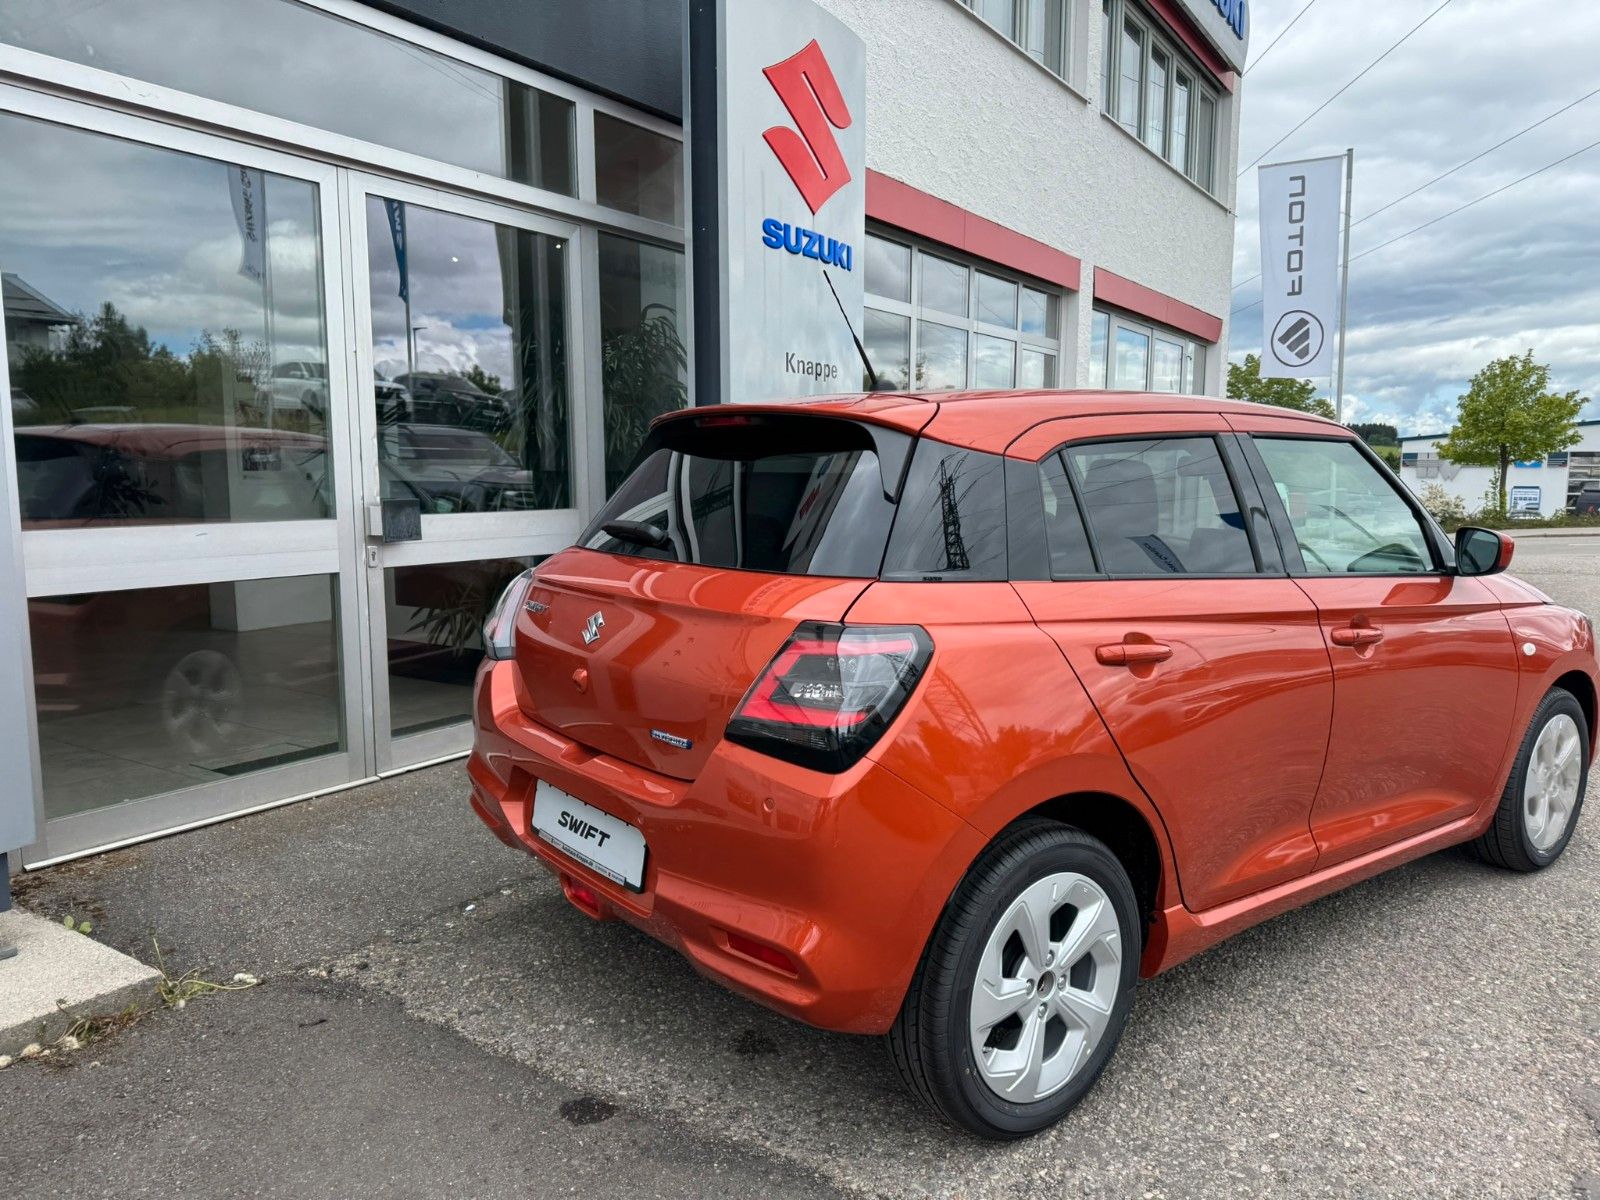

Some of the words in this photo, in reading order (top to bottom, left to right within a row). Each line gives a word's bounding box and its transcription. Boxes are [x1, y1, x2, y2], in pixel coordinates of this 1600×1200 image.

[761, 217, 853, 272] SUZUKI
[785, 351, 838, 382] Knappe
[557, 810, 611, 848] SWIFT
